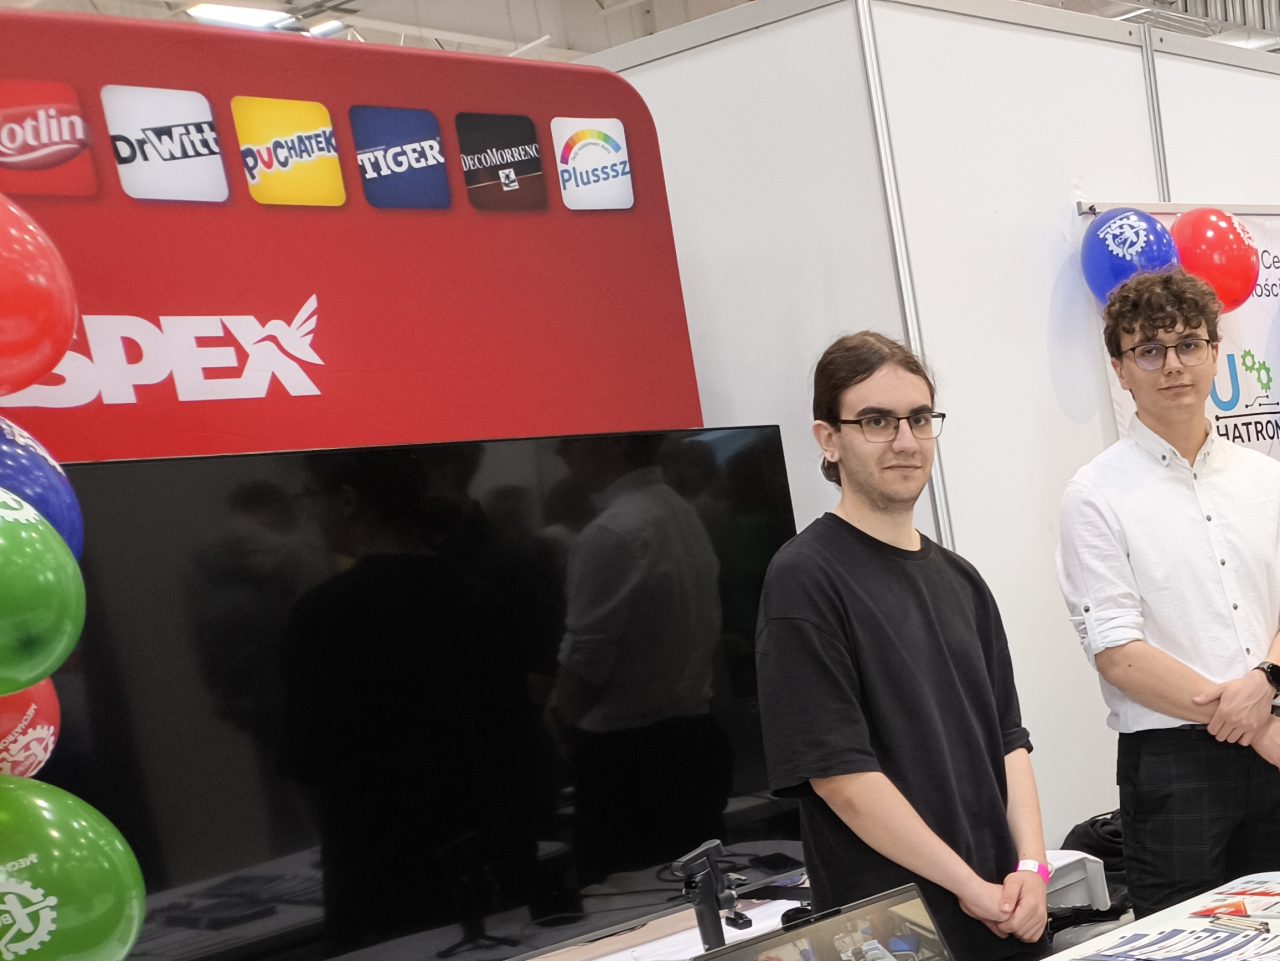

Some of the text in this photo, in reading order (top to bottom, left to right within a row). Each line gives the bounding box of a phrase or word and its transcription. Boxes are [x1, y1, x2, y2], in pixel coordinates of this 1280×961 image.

[0, 108, 85, 149] otlin
[112, 122, 219, 165] DrWitt
[357, 139, 445, 180] TIGER
[560, 160, 632, 191] Plusssz
